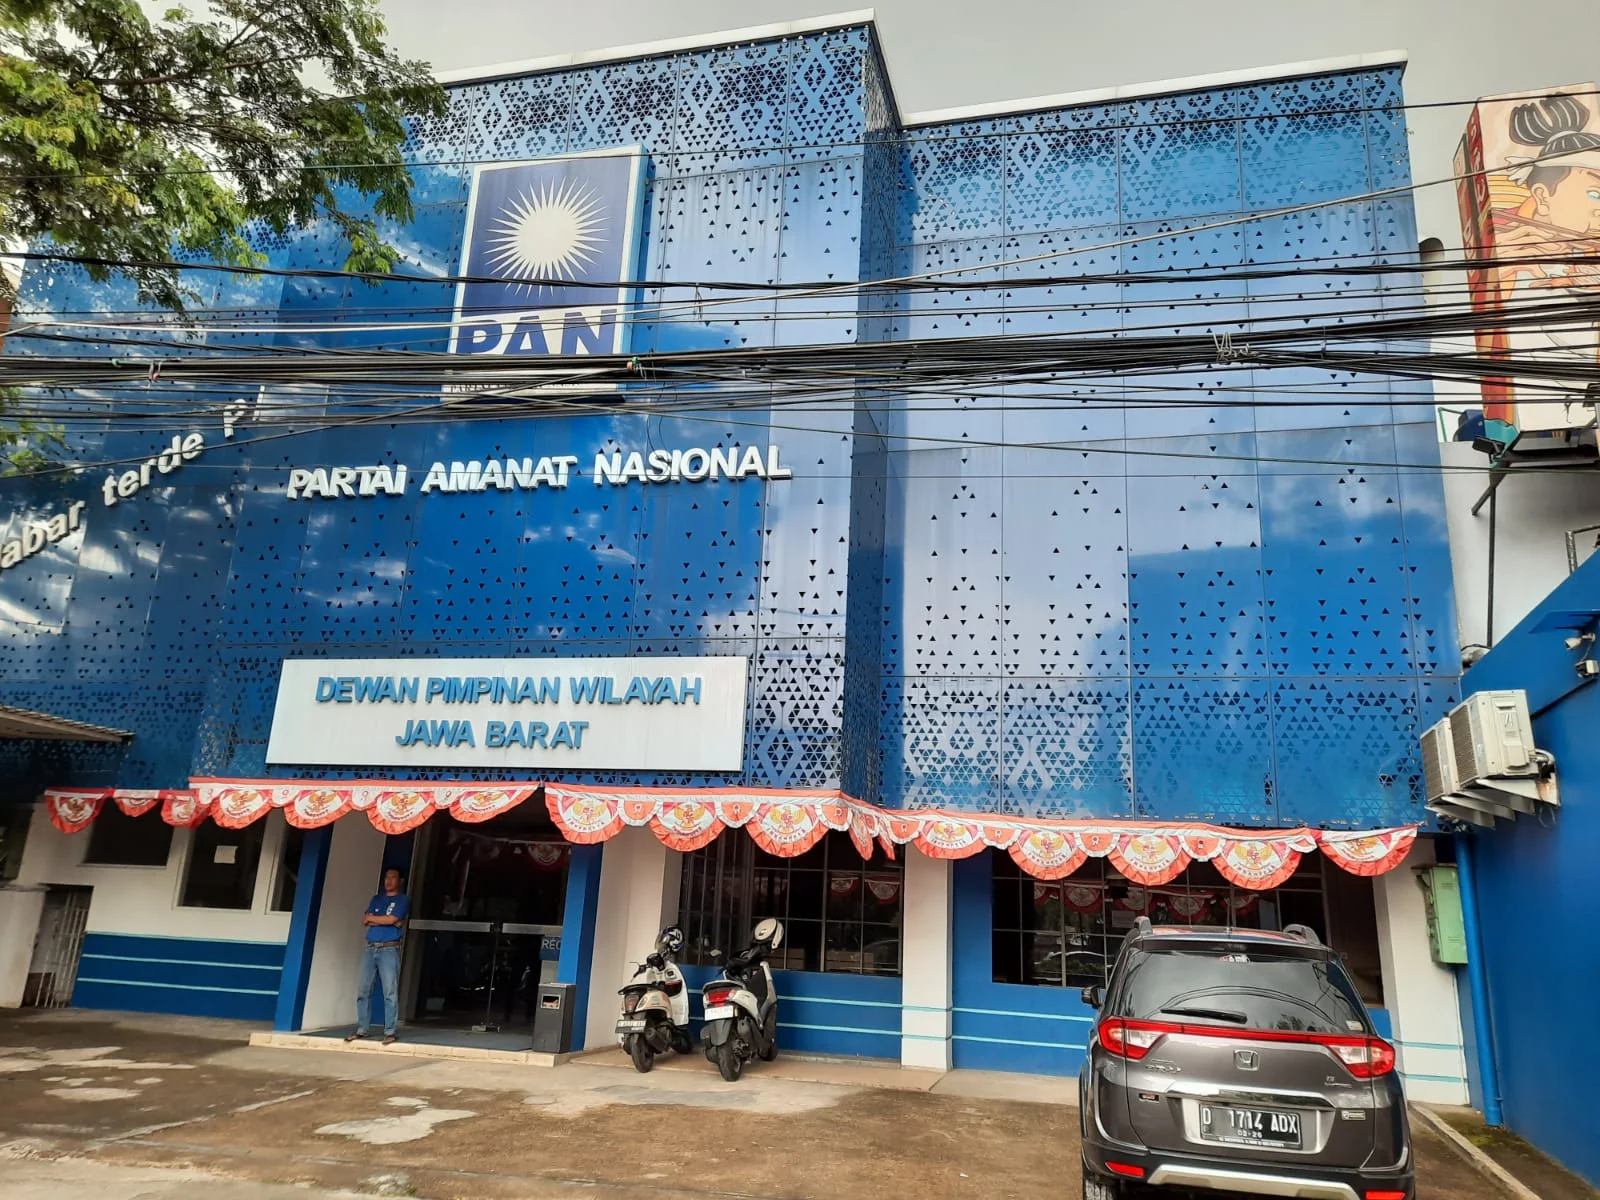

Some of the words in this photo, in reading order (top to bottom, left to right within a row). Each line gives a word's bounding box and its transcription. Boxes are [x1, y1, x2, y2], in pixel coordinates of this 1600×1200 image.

[456, 308, 618, 356] PAN
[102, 433, 205, 506] terde
[286, 464, 408, 500] PARTAI
[419, 455, 578, 494] AMANAT
[593, 445, 793, 486] NASIONAL
[315, 676, 419, 703] DEWAN
[425, 676, 561, 704] PIMPINAN
[569, 676, 702, 705] WILAYAH
[395, 719, 476, 748] JAWA
[485, 720, 589, 751] BARAT
[1202, 1107, 1212, 1125] D
[1228, 1110, 1264, 1130] 1714
[1270, 1113, 1298, 1135] ADX
